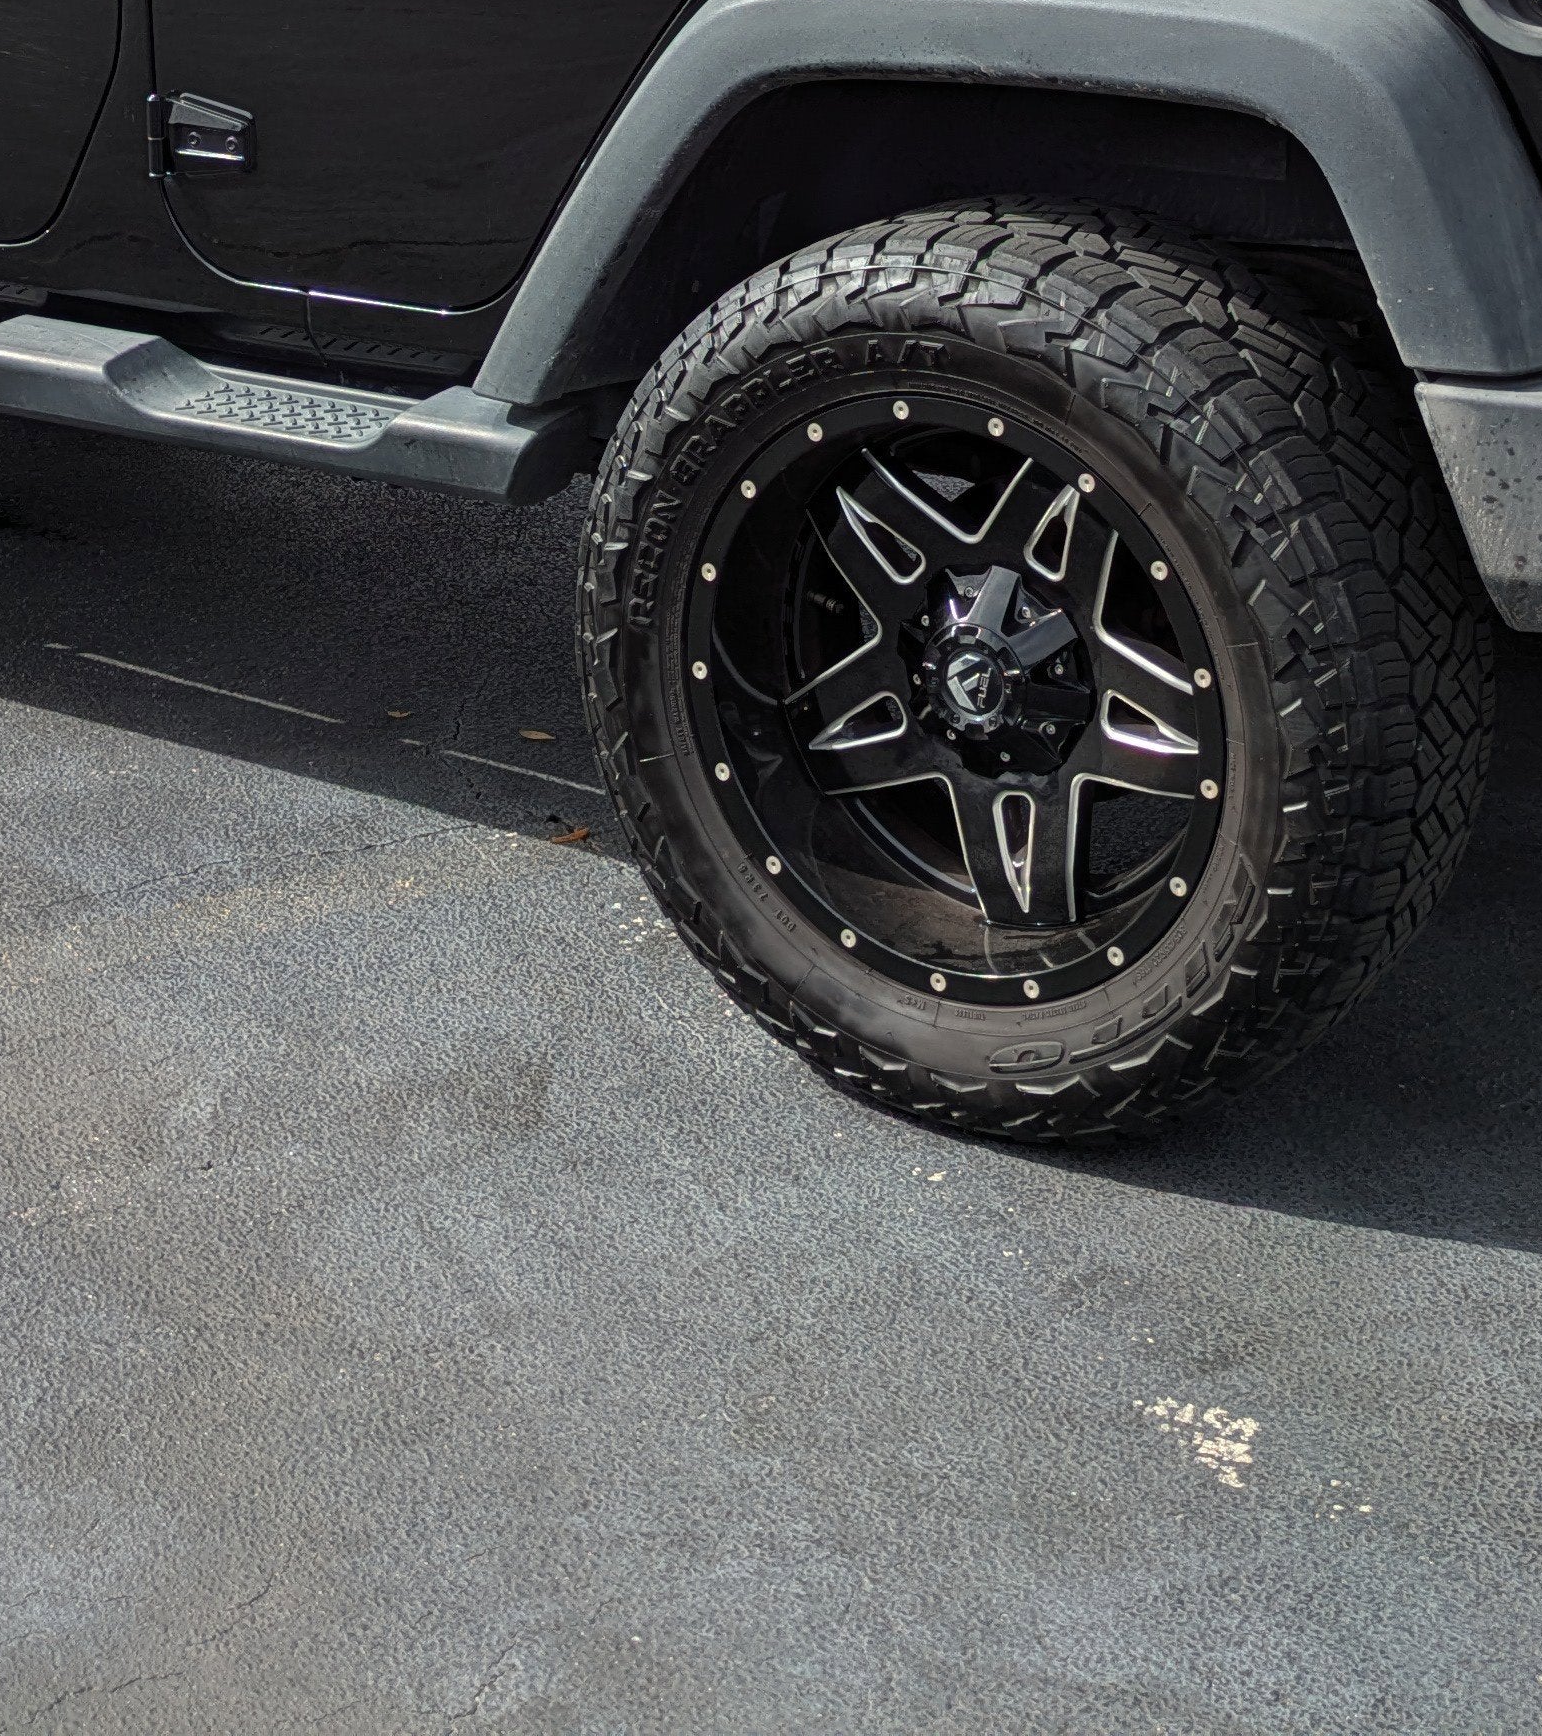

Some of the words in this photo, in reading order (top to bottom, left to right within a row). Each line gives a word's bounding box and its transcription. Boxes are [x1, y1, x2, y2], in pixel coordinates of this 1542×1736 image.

[627, 489, 682, 627] RECON
[669, 346, 846, 485] GRAPPLER
[976, 667, 992, 709] FUEL
[988, 851, 1257, 1075] NITTO
